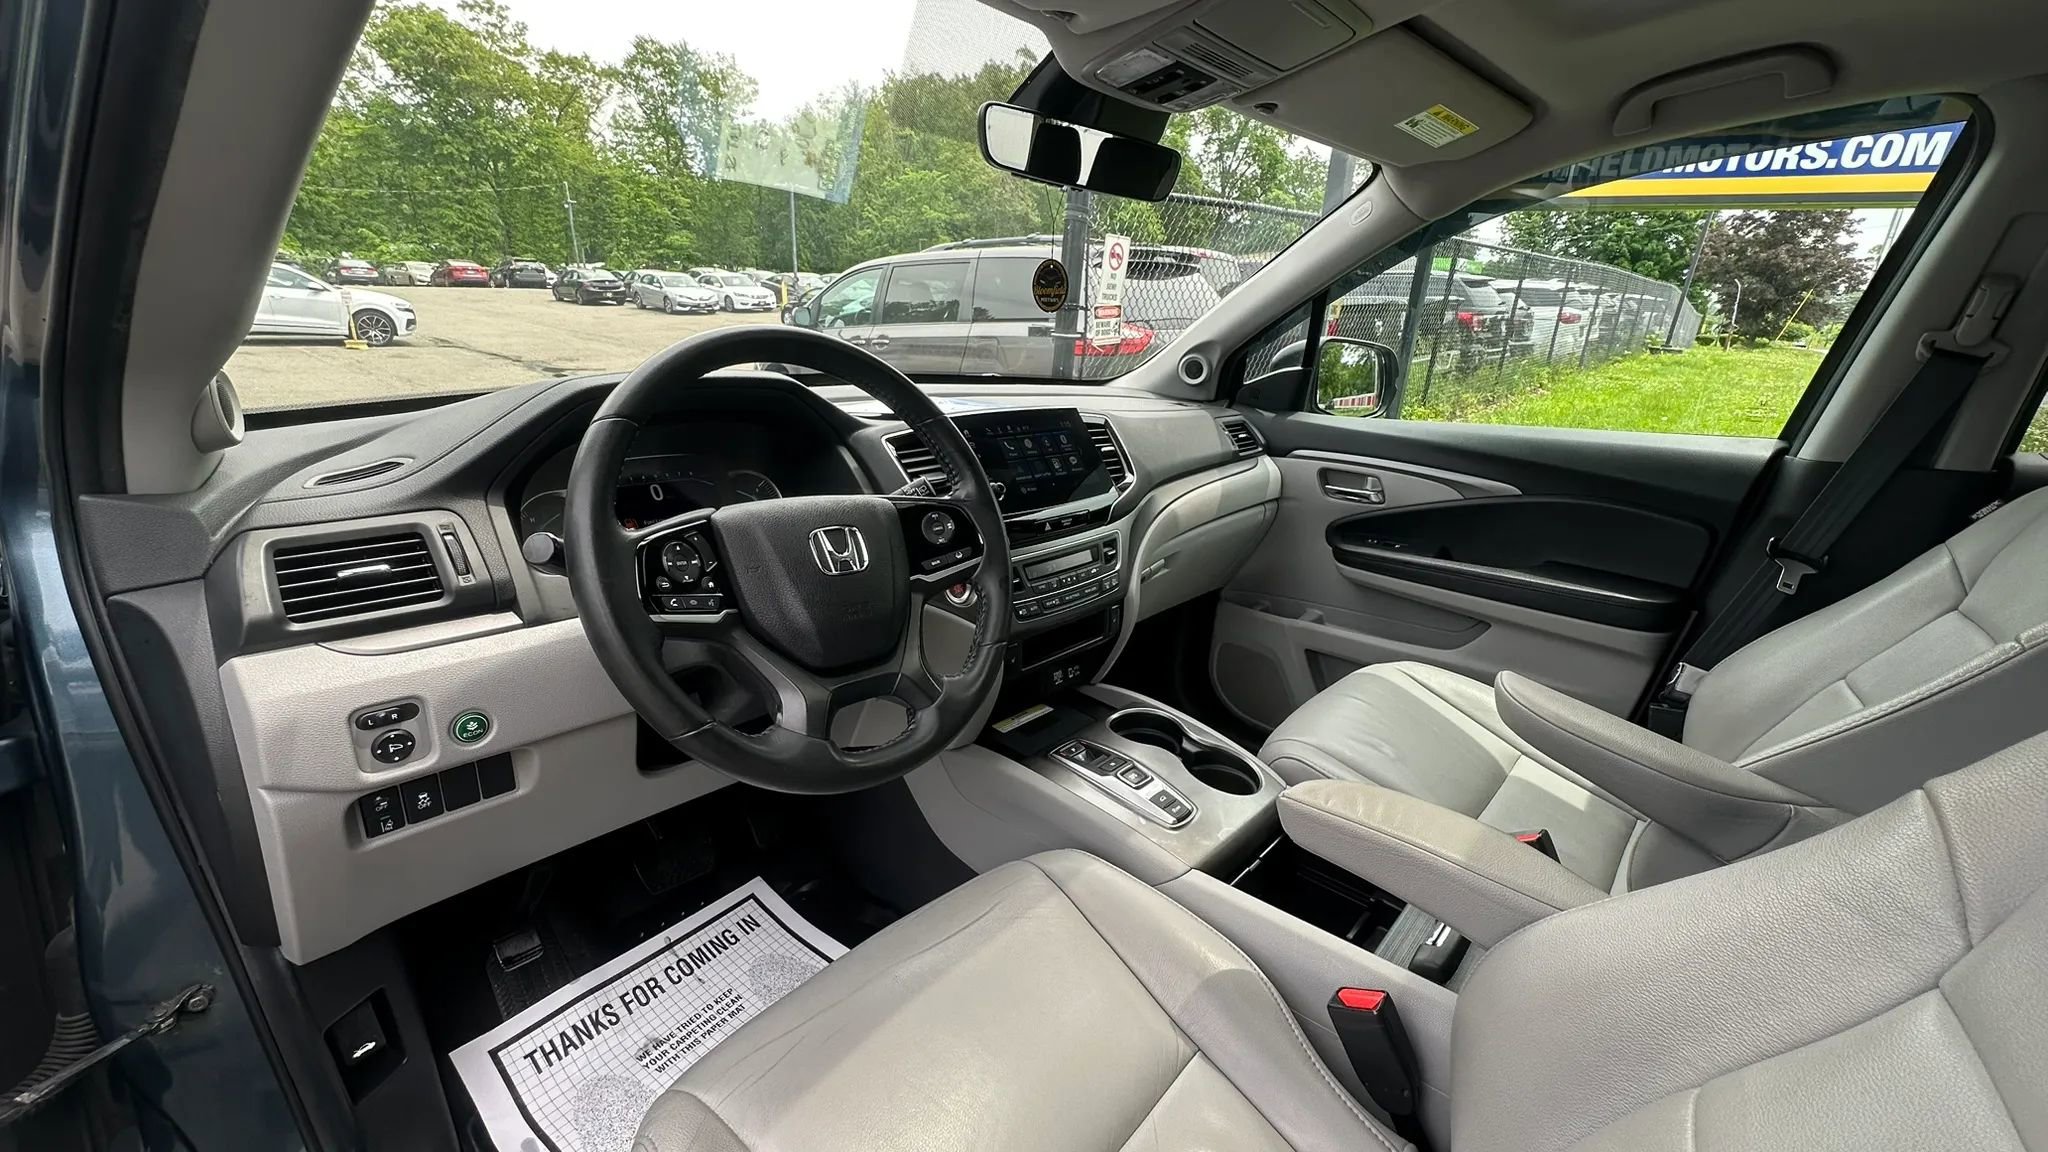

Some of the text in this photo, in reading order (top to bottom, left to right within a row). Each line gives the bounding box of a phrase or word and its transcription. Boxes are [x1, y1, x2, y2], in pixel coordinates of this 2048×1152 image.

[650, 484, 663, 501] 0
[462, 728, 484, 738] ECON
[417, 800, 432, 810] OFF
[523, 914, 761, 1075] THANKS FOR COMING IN
[636, 988, 734, 1062] WE HAVE TRIED TO KEEP
[643, 994, 743, 1070] YOUR CARPETING CLEAN
[654, 1003, 746, 1074] WITH THIS PAPER MAT
